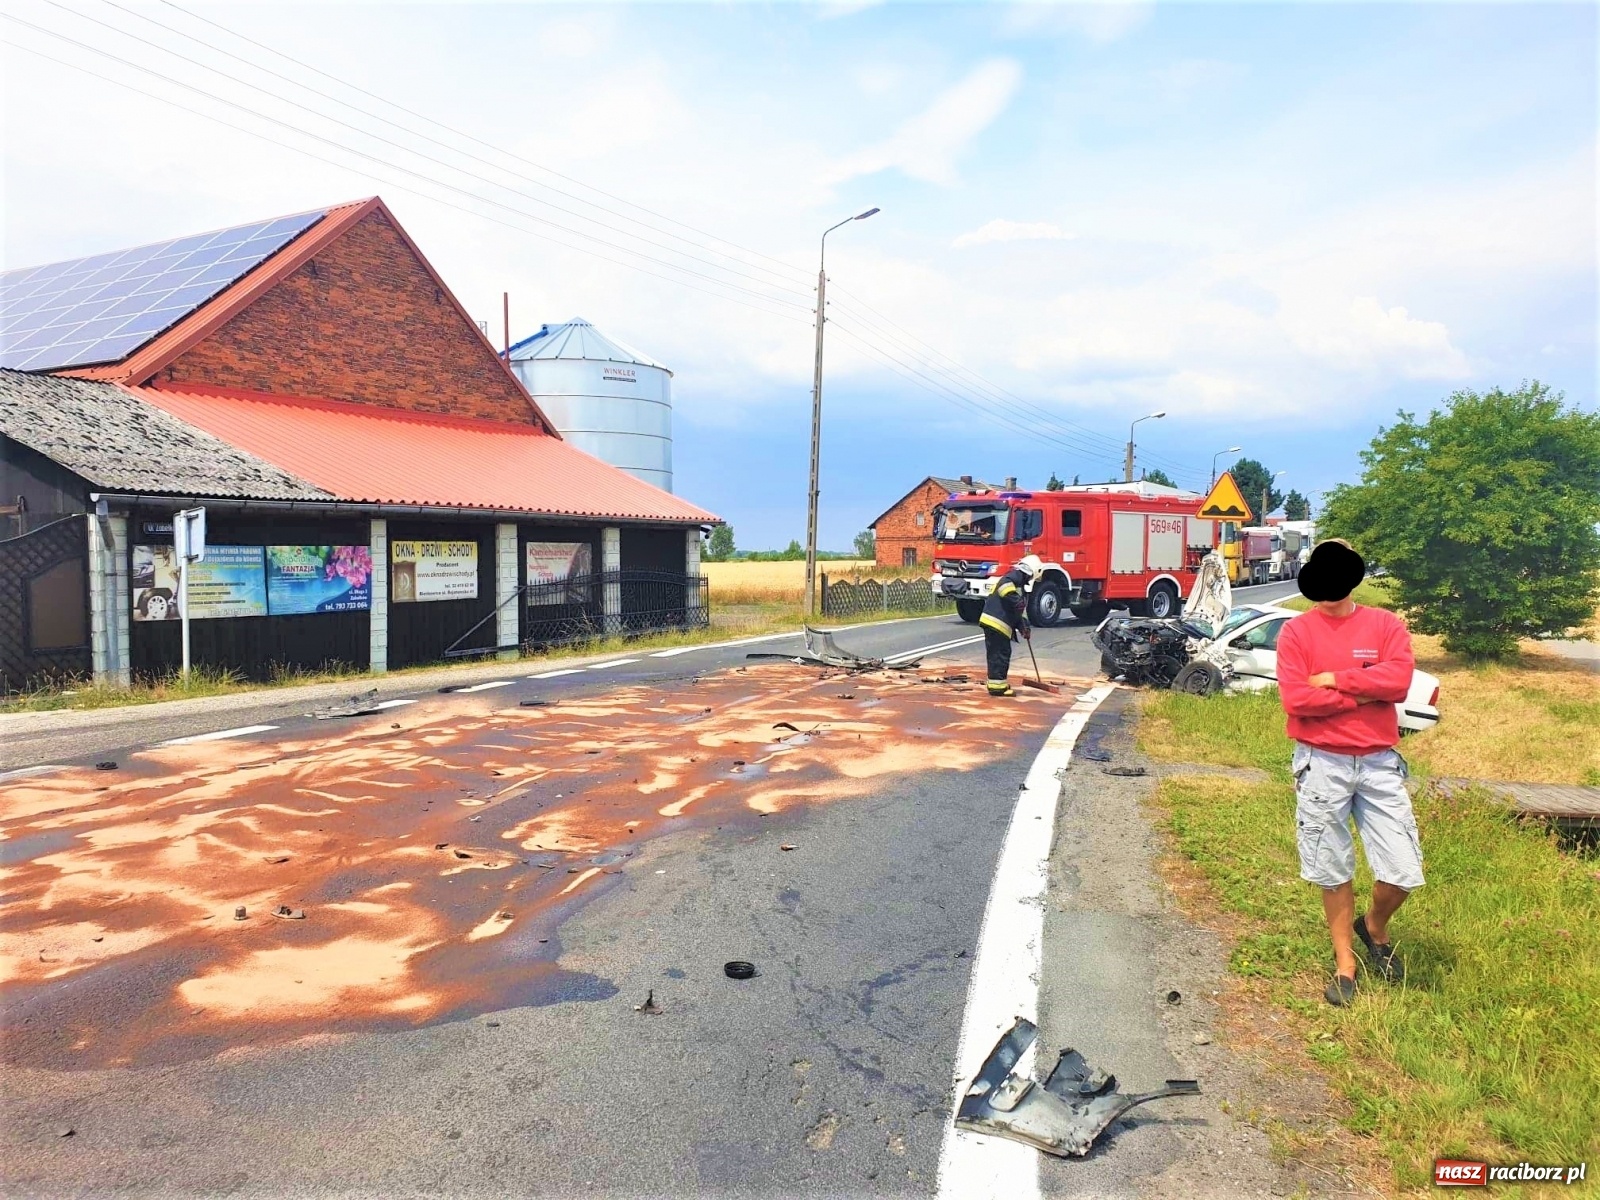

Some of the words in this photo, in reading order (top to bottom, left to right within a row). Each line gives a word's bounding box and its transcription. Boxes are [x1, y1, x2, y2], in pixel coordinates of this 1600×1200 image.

[604, 368, 636, 376] WINKLER
[396, 544, 416, 558] OKNA
[421, 544, 442, 558] DRZWI
[448, 544, 474, 558] SCHODY
[282, 565, 315, 573] FANTAZJA
